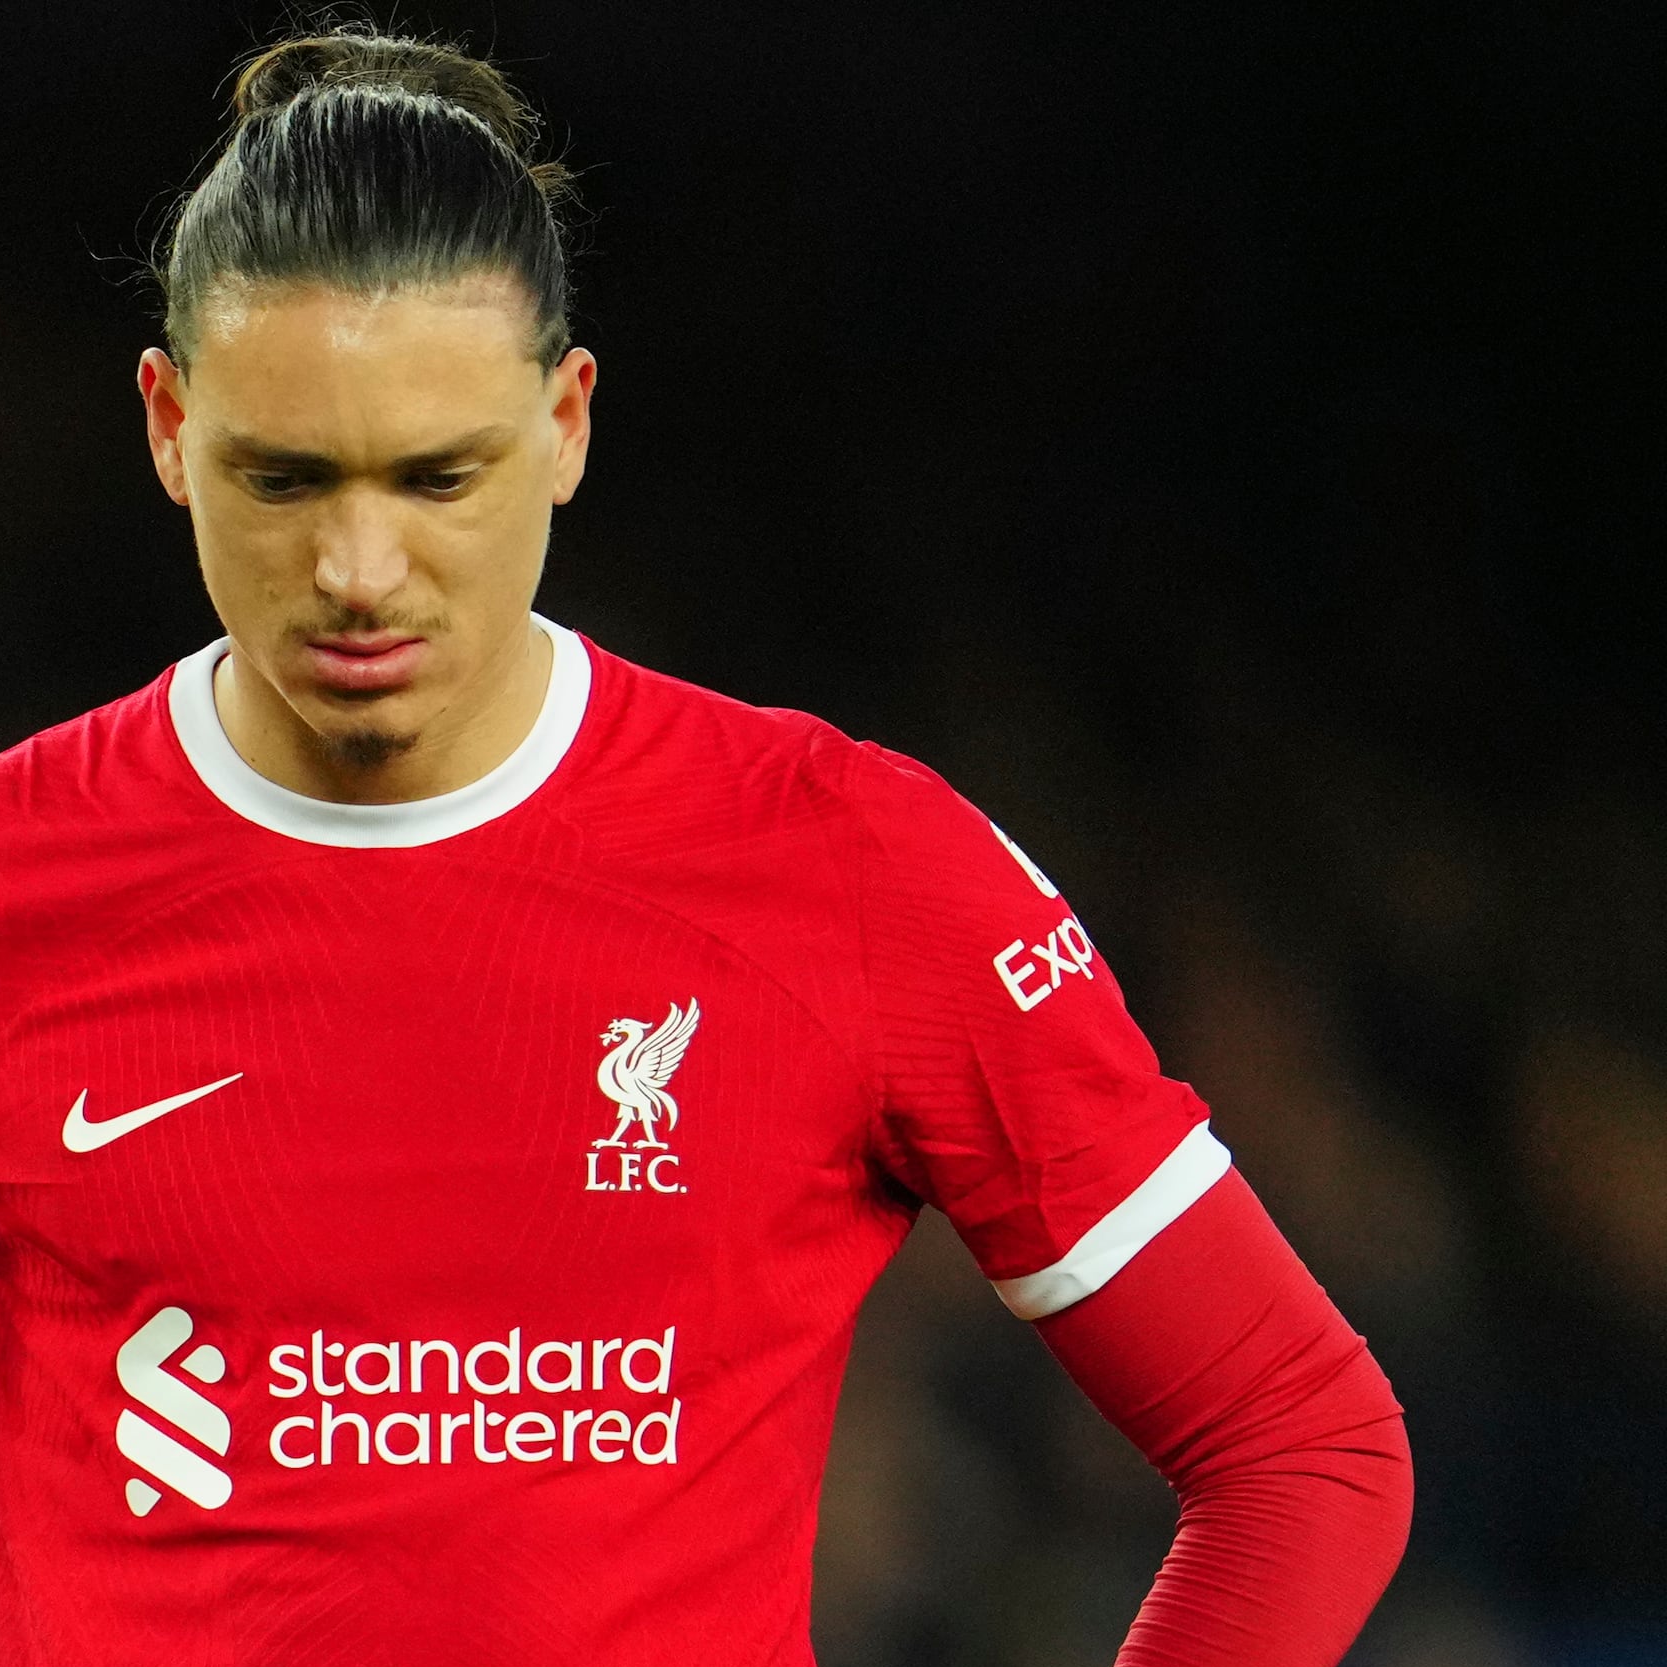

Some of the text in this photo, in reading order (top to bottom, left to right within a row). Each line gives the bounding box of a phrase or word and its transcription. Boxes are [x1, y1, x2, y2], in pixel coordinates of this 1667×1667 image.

[993, 913, 1095, 1012] Exp
[584, 1152, 688, 1194] L.F.C.
[268, 1325, 676, 1399] standard
[269, 1397, 682, 1469] chartered
